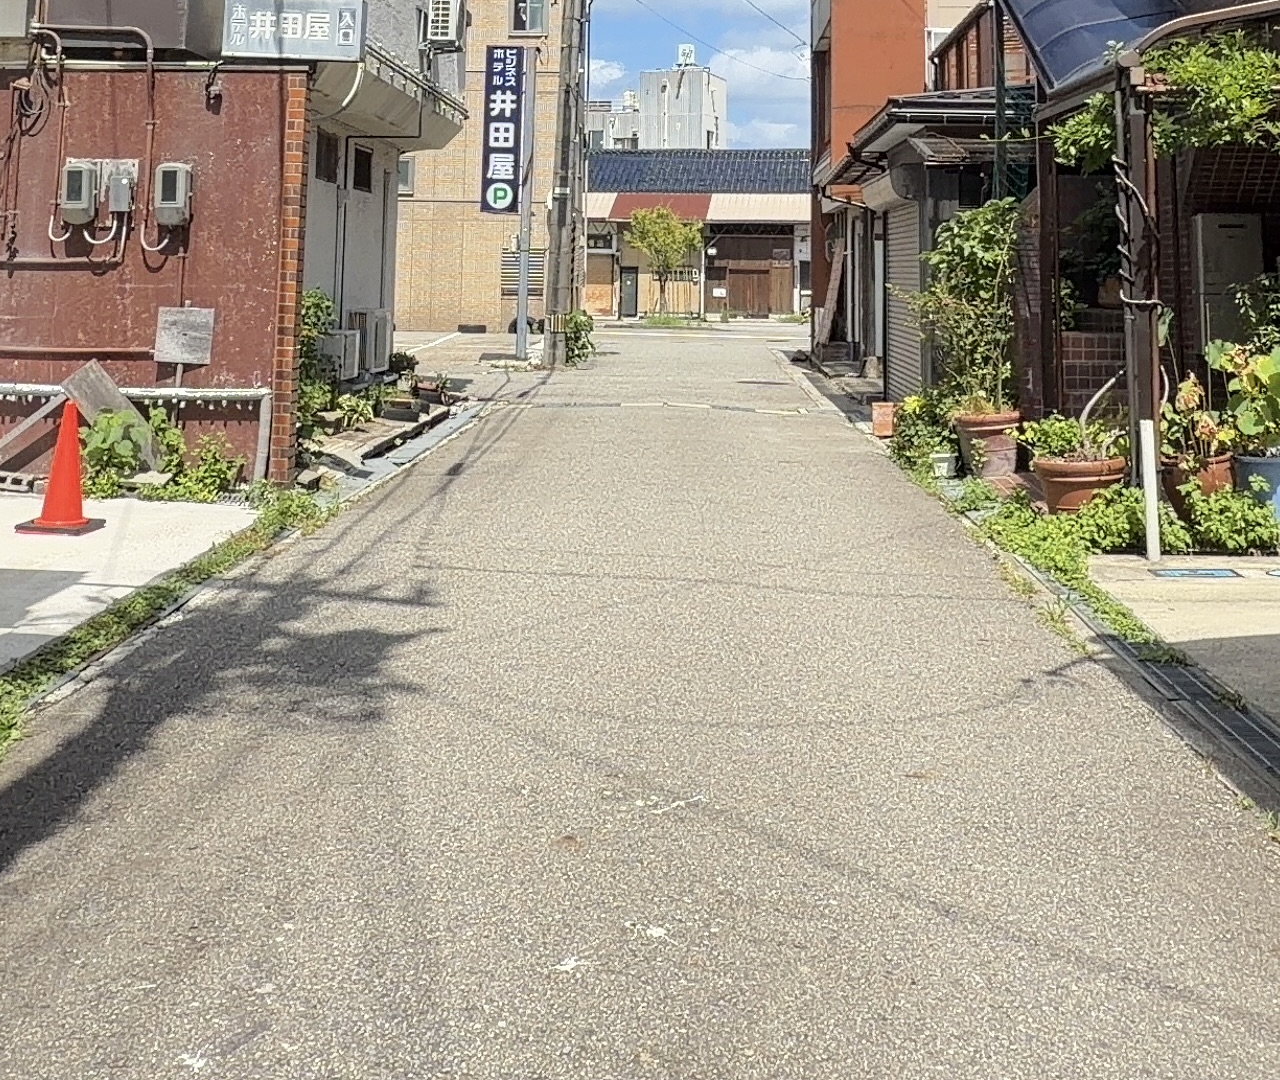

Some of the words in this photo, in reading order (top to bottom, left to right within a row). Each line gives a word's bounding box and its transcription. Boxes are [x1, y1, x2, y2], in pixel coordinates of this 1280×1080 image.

[230, 2, 247, 46] ホテル
[249, 10, 331, 41] 井田屋
[339, 12, 356, 45] 入口
[492, 48, 505, 86] ホテル
[505, 48, 518, 87] ビジネス
[486, 89, 518, 181] 井田屋
[493, 187, 508, 205] P
